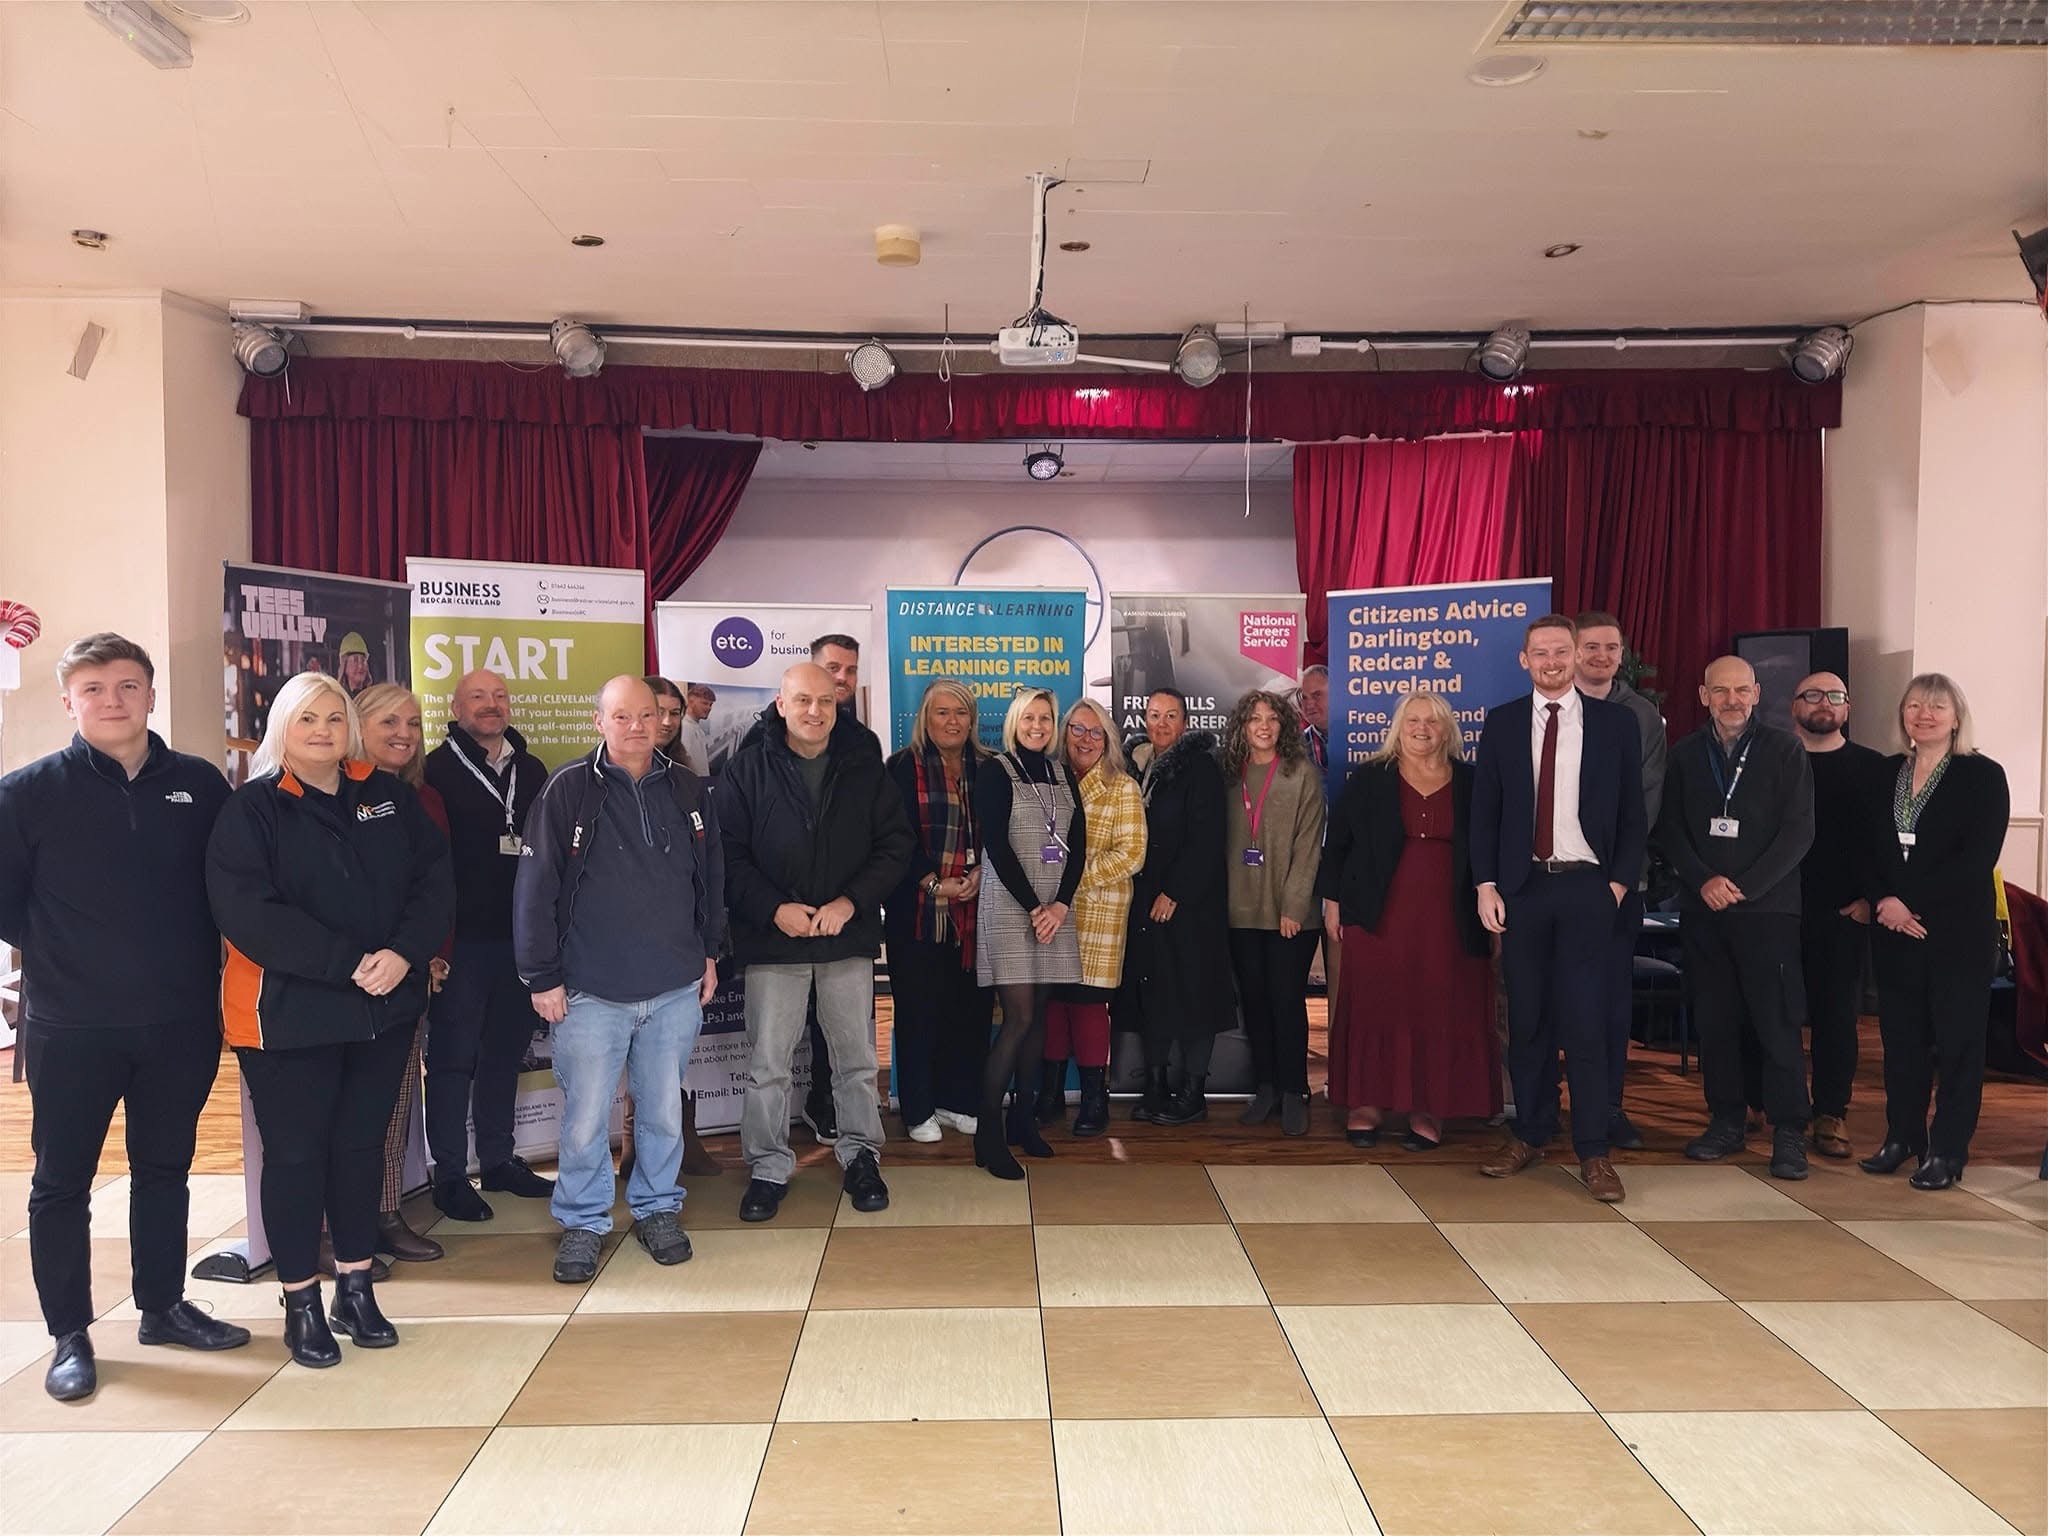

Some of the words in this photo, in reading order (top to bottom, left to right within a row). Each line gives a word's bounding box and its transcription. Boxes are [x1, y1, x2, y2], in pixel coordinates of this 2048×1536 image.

[420, 581, 501, 598] BUSINESS
[240, 584, 305, 616] TEES
[899, 602, 975, 616] DISTANCE
[996, 603, 1074, 617] LEARNING
[1348, 605, 1440, 626] Citizens
[1444, 599, 1527, 621] Advice
[241, 610, 327, 643] VALLEY
[1243, 615, 1296, 627] National
[770, 629, 786, 640] for
[1243, 626, 1290, 637] Careers
[716, 633, 753, 650] etc.
[910, 636, 1039, 653] INTERESTED
[1043, 636, 1064, 653] IN
[1243, 637, 1288, 648] Service
[1348, 628, 1479, 651] Darlington,
[423, 633, 575, 681] START
[770, 645, 810, 655] busine
[904, 659, 1009, 676] LEARNING
[1014, 659, 1071, 676] FROM
[1348, 652, 1428, 672] Redcar
[1433, 651, 1452, 669] &
[1348, 674, 1462, 695] Cleveland
[423, 694, 444, 703] The
[424, 710, 445, 718] can
[528, 708, 552, 719] your
[1347, 710, 1391, 725] Free,
[542, 735, 559, 744] the
[560, 735, 580, 744] first
[703, 1053, 729, 1064] about
[729, 1071, 748, 1081] Tel:
[697, 1087, 729, 1099] Email:
